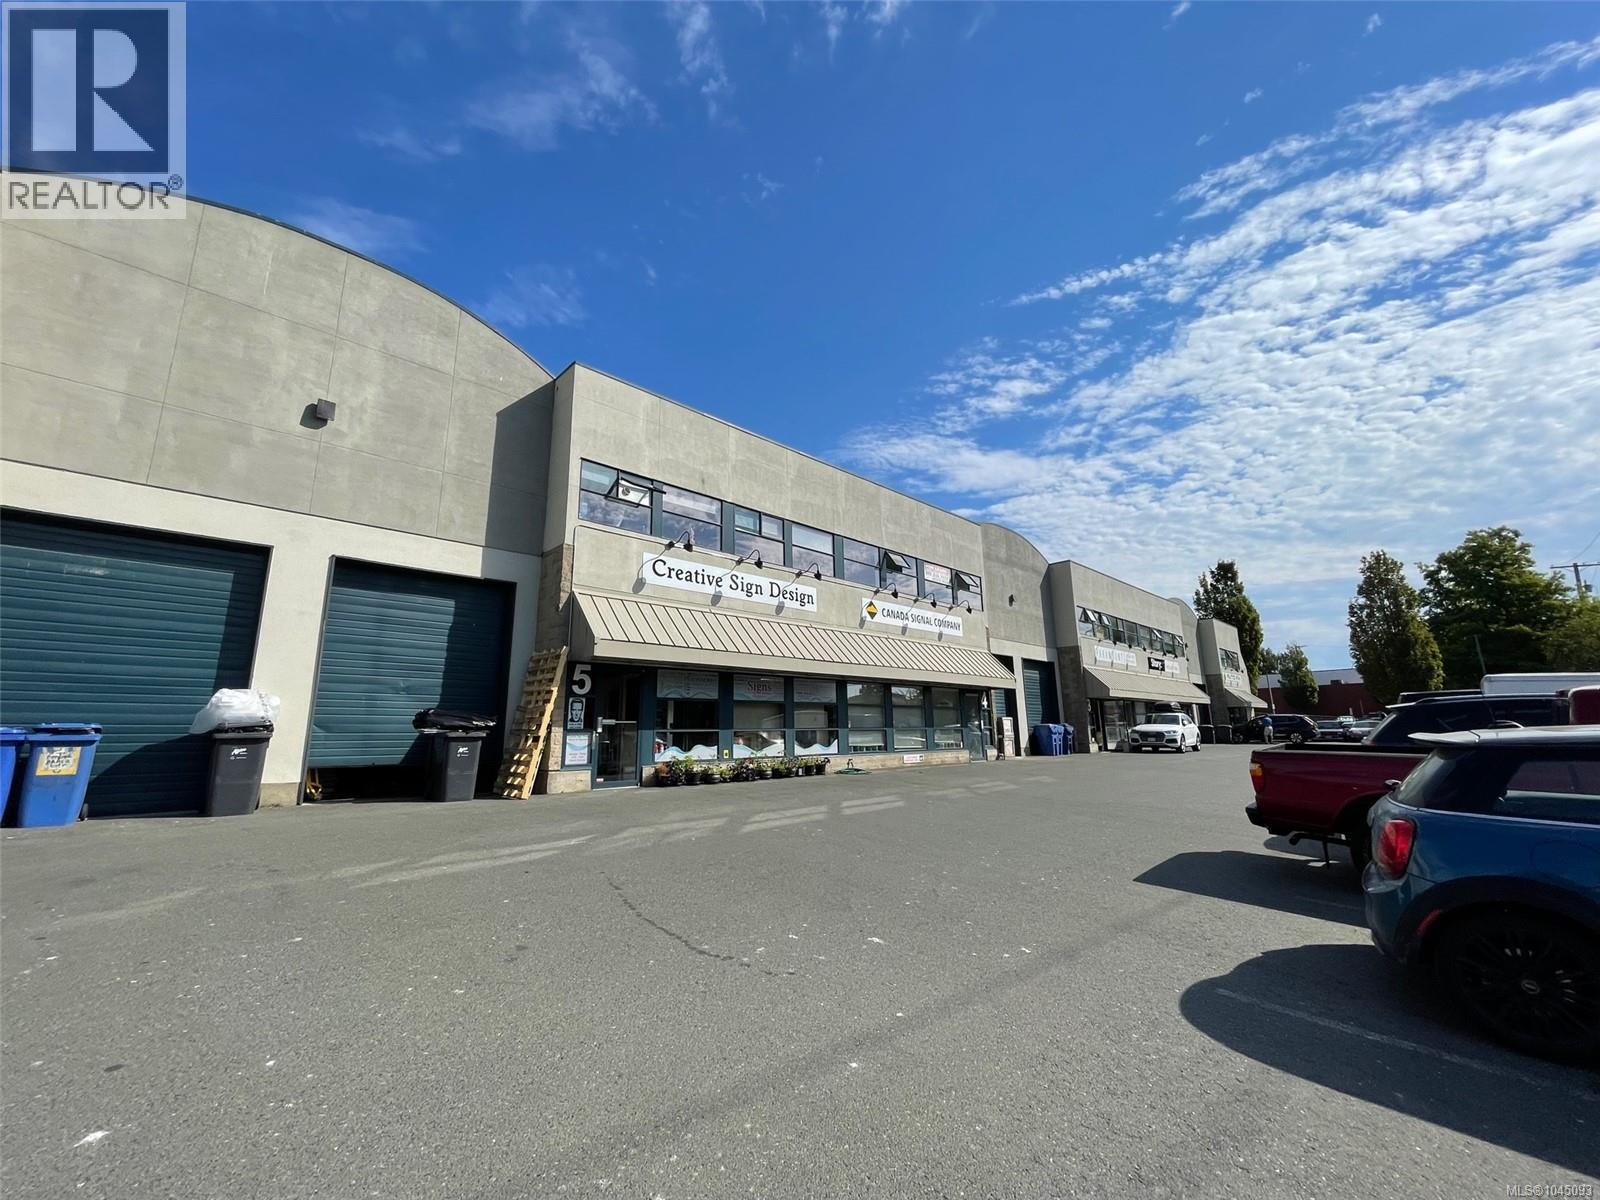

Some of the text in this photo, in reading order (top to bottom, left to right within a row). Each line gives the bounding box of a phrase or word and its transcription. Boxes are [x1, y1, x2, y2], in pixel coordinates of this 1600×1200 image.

[652, 559, 814, 607] Creative Sign Design
[881, 607, 961, 631] CANADA SIGNAL COMPANY
[571, 663, 592, 695] 5
